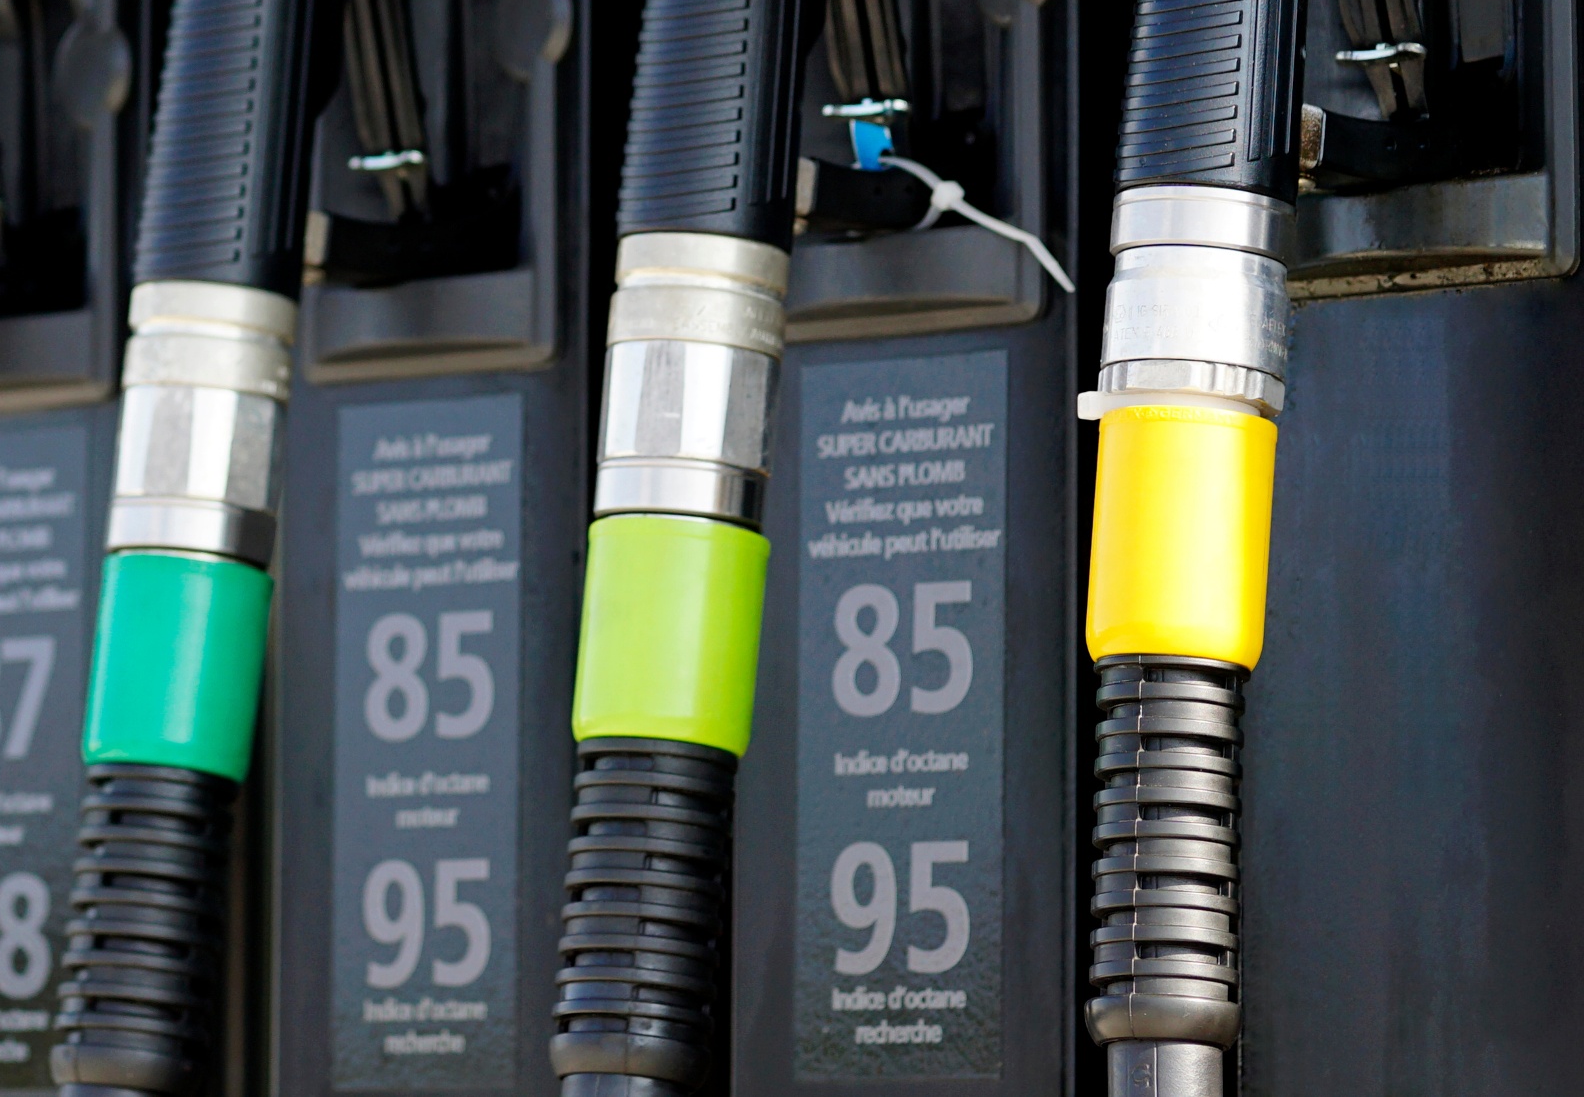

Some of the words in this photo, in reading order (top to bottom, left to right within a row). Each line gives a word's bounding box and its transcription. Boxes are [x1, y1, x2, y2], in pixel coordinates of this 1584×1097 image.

[841, 399, 881, 424] Avis
[883, 397, 895, 420] à
[898, 395, 971, 422] l'usager
[817, 432, 876, 459] SUPER
[879, 423, 994, 453] CARBURANT
[844, 463, 895, 491] SANS
[898, 459, 965, 486] PLOMB
[897, 501, 932, 526] que
[935, 494, 984, 516] votre
[884, 530, 929, 560] peut
[832, 580, 974, 718] 85
[364, 610, 495, 742] 85
[834, 751, 888, 775] Indice
[890, 748, 969, 772] d'octane
[867, 786, 935, 808] moteur
[362, 858, 492, 989] 95
[830, 840, 971, 976] 95
[831, 987, 887, 1011] Indice
[889, 985, 967, 1010] d'octane
[855, 1020, 943, 1045] recherche
